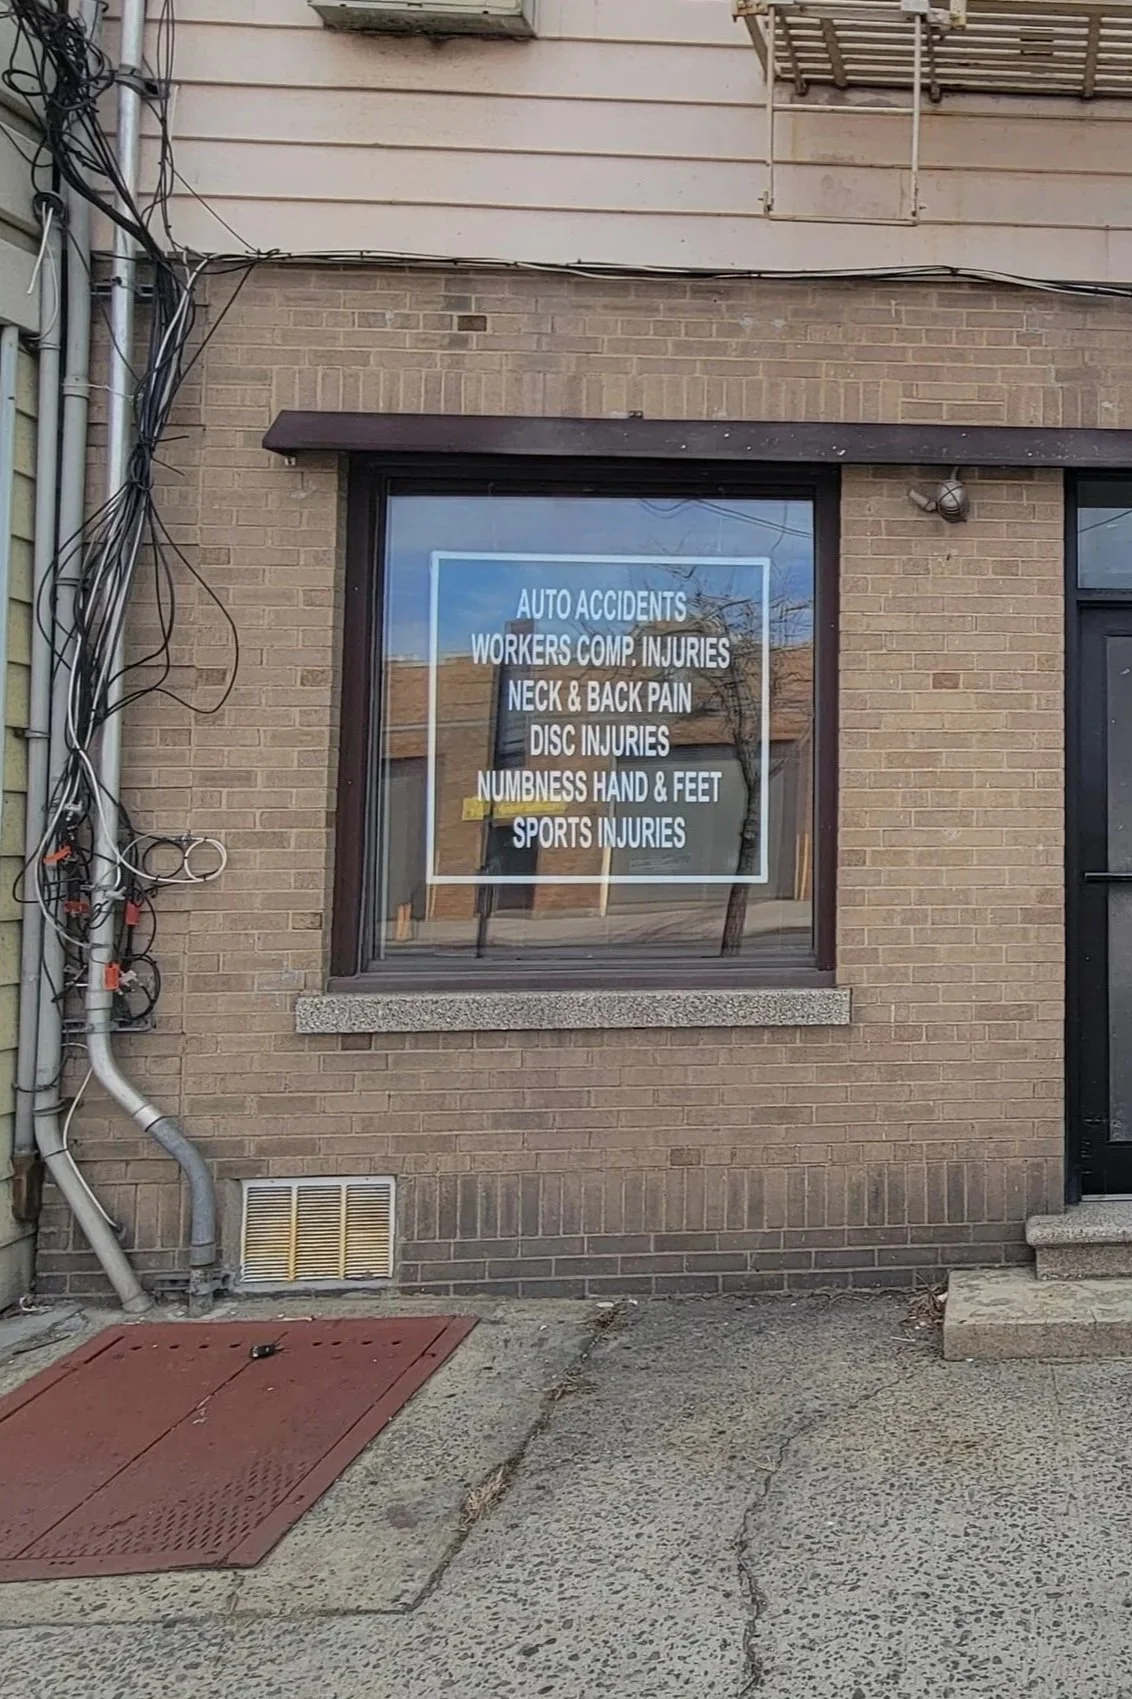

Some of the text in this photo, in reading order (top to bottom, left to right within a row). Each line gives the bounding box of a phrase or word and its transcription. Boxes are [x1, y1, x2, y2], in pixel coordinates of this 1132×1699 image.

[517, 588, 687, 622] AUTO ACCIDENTS
[472, 633, 731, 669] WORKERS COMP. INJURIES
[508, 680, 692, 714] NECK & BACK PAIN
[530, 724, 670, 757] DISC INJURIES
[477, 770, 722, 803] NUMBNESS HAND & FEET
[512, 816, 686, 850] SPORTS INJURIES
